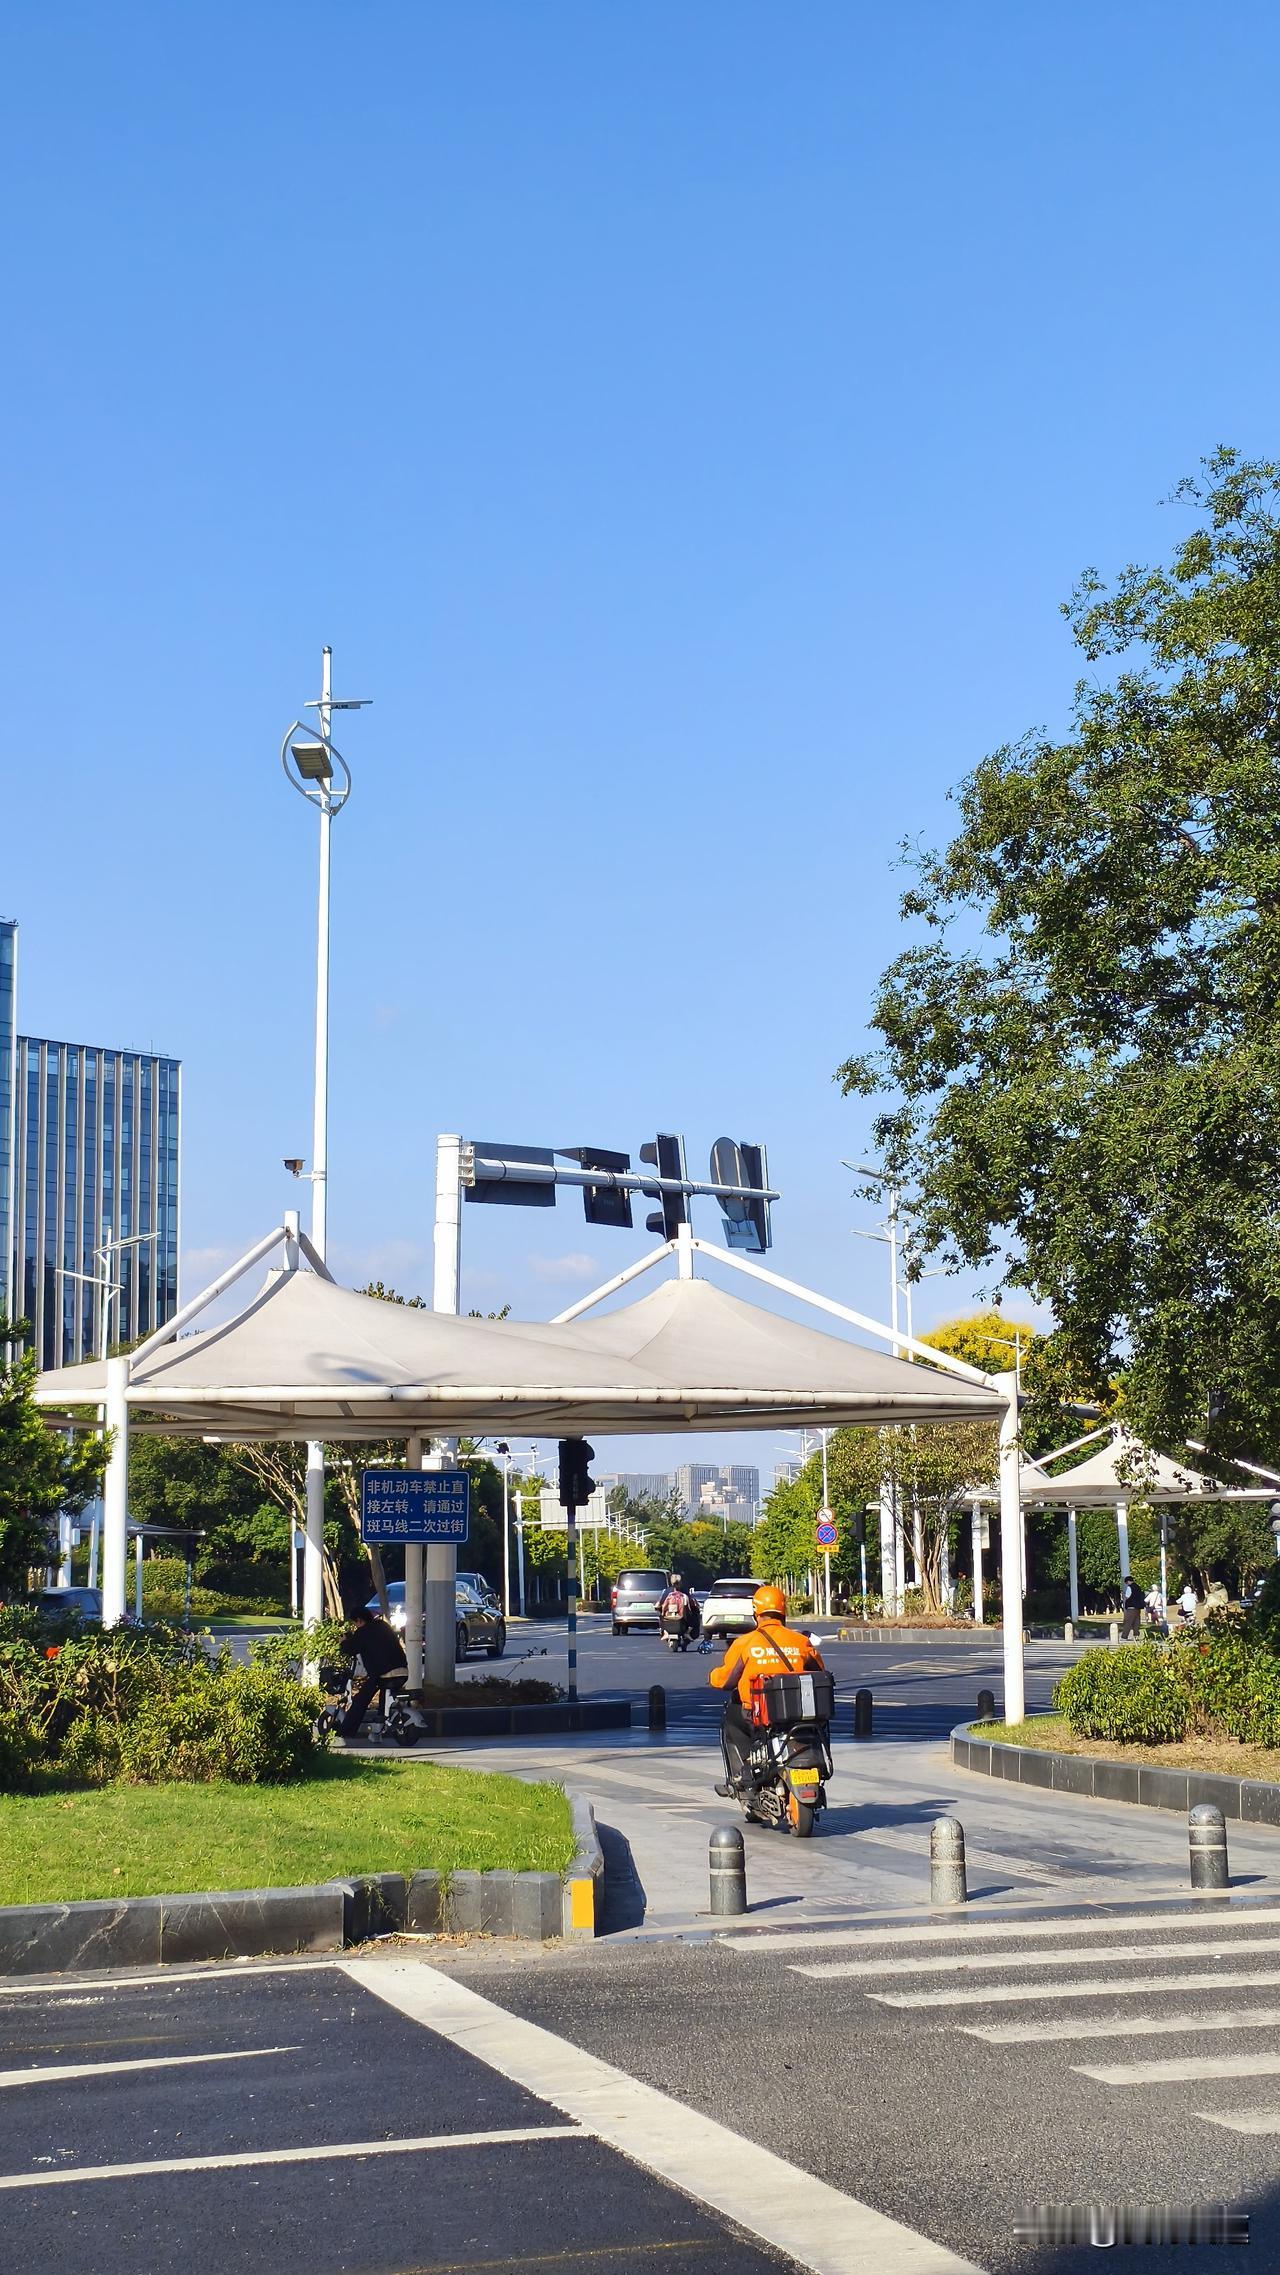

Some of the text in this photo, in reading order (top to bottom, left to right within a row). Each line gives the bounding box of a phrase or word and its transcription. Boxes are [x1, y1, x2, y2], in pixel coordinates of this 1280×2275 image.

[367, 1480, 465, 1494] 非机动车禁止直
[367, 1519, 465, 1534] 斑马线二次过街
